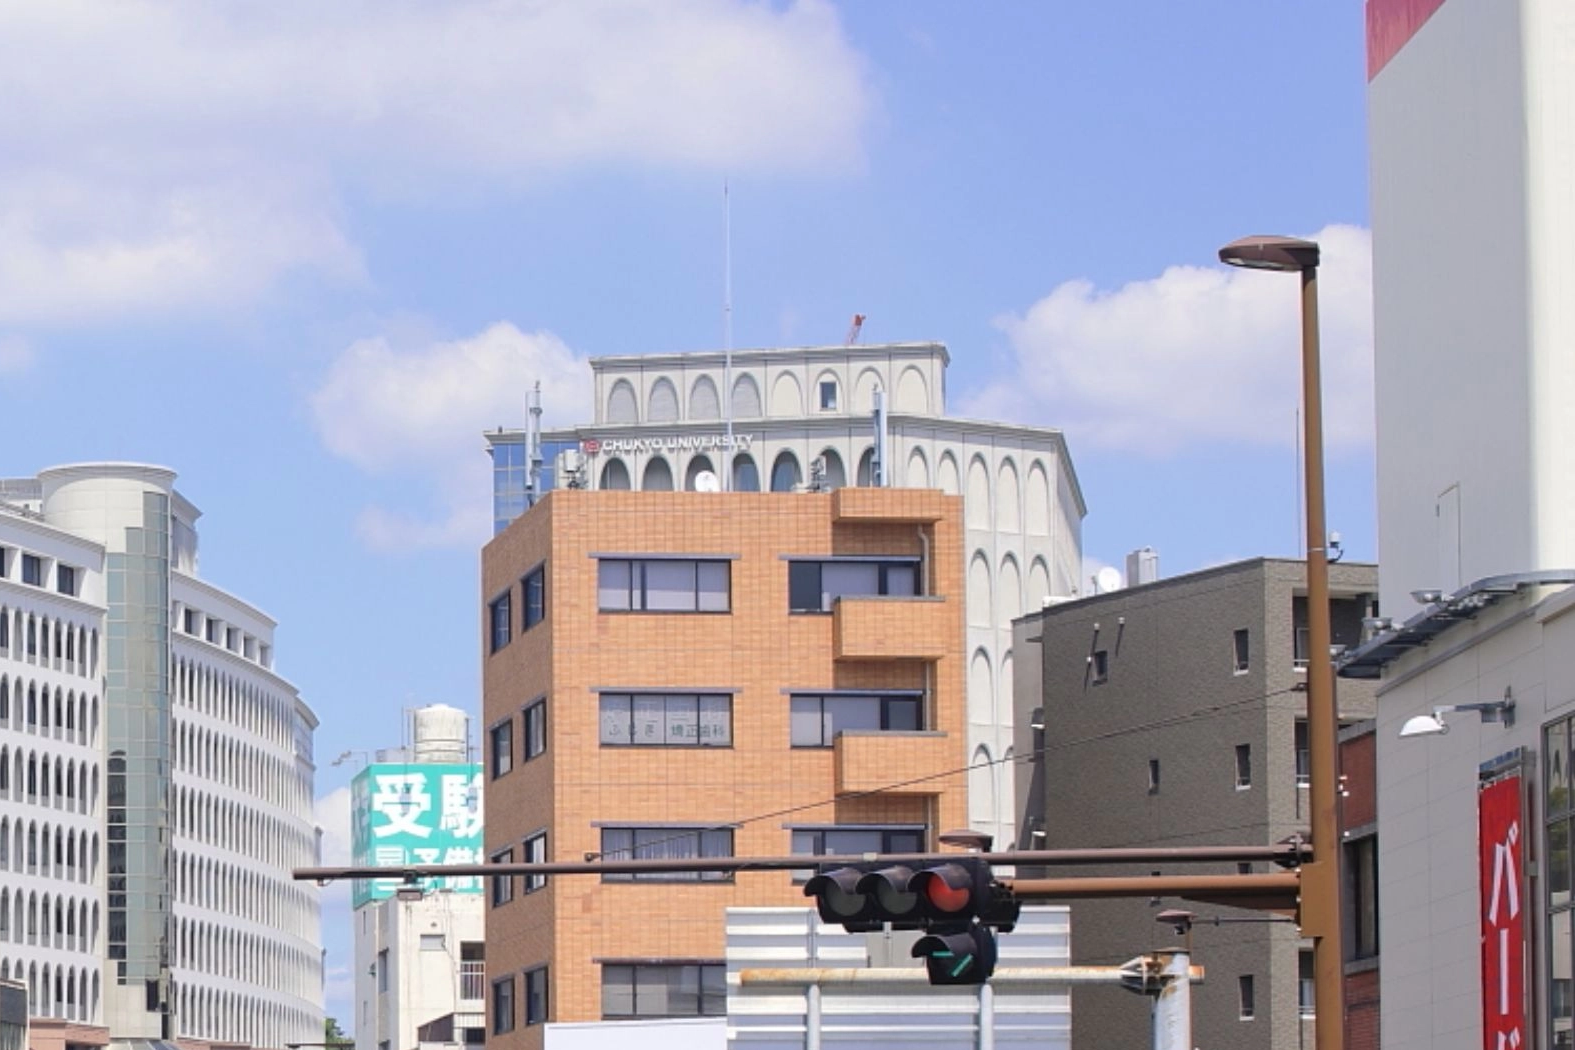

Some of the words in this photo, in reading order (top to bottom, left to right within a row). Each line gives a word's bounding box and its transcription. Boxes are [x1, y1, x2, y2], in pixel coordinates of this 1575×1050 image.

[602, 437, 662, 450] CHUKYO
[667, 434, 753, 448] UNIVERSITY
[372, 771, 484, 839] 受験
